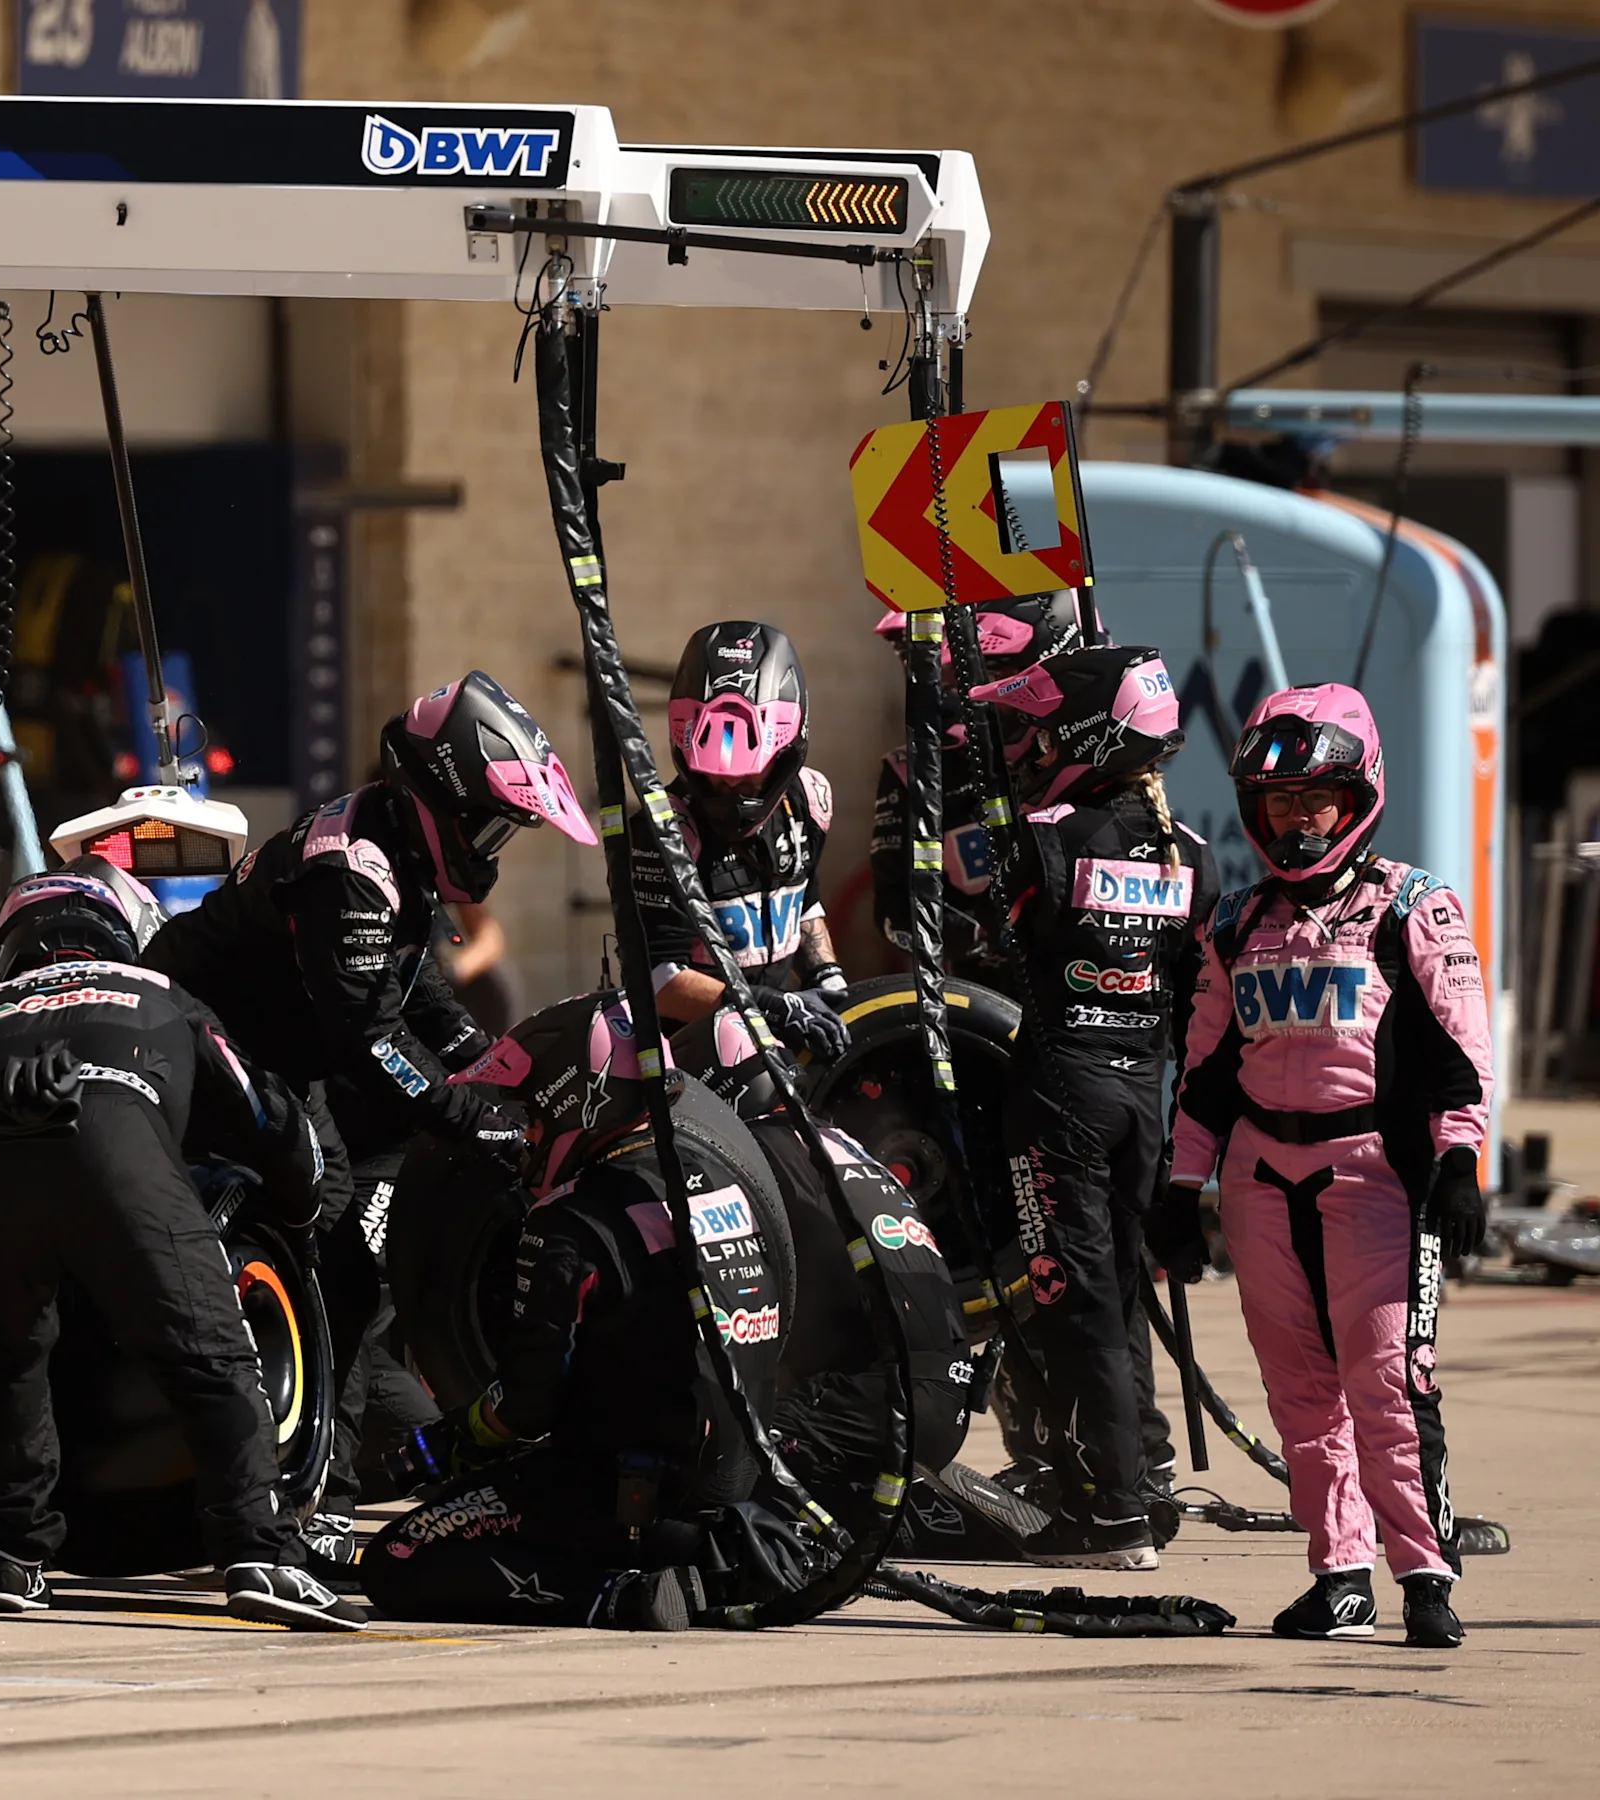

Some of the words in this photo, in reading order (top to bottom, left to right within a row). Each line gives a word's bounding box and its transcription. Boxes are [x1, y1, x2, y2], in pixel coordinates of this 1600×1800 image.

[419, 128, 558, 175] BWT
[1006, 676, 1029, 693] BWT
[1069, 710, 1109, 735] shamir
[1073, 735, 1101, 759] JAAQ
[427, 762, 444, 783] JA
[443, 755, 468, 799] shamir
[1123, 876, 1184, 908] BWT
[19, 987, 141, 1014] Castrol
[1233, 965, 1369, 1029] BWT
[381, 1048, 431, 1098] BWT
[473, 1052, 495, 1073] BWT
[545, 1063, 579, 1098] shamir
[551, 1093, 581, 1119] JAAQ
[1028, 1146, 1046, 1168] sip
[1008, 1155, 1039, 1255] CHANGE
[1018, 1154, 1047, 1232] WORLD
[1040, 1193, 1059, 1217] sip
[701, 1200, 750, 1235] BWT
[701, 1235, 767, 1263] LPINE
[1036, 1232, 1047, 1252] THE
[738, 1264, 764, 1280] TEAM
[1417, 1233, 1434, 1338] CHANGE
[1428, 1236, 1442, 1318] WORLD
[407, 1485, 499, 1540] CHANGE
[430, 1500, 508, 1538] WORLD
